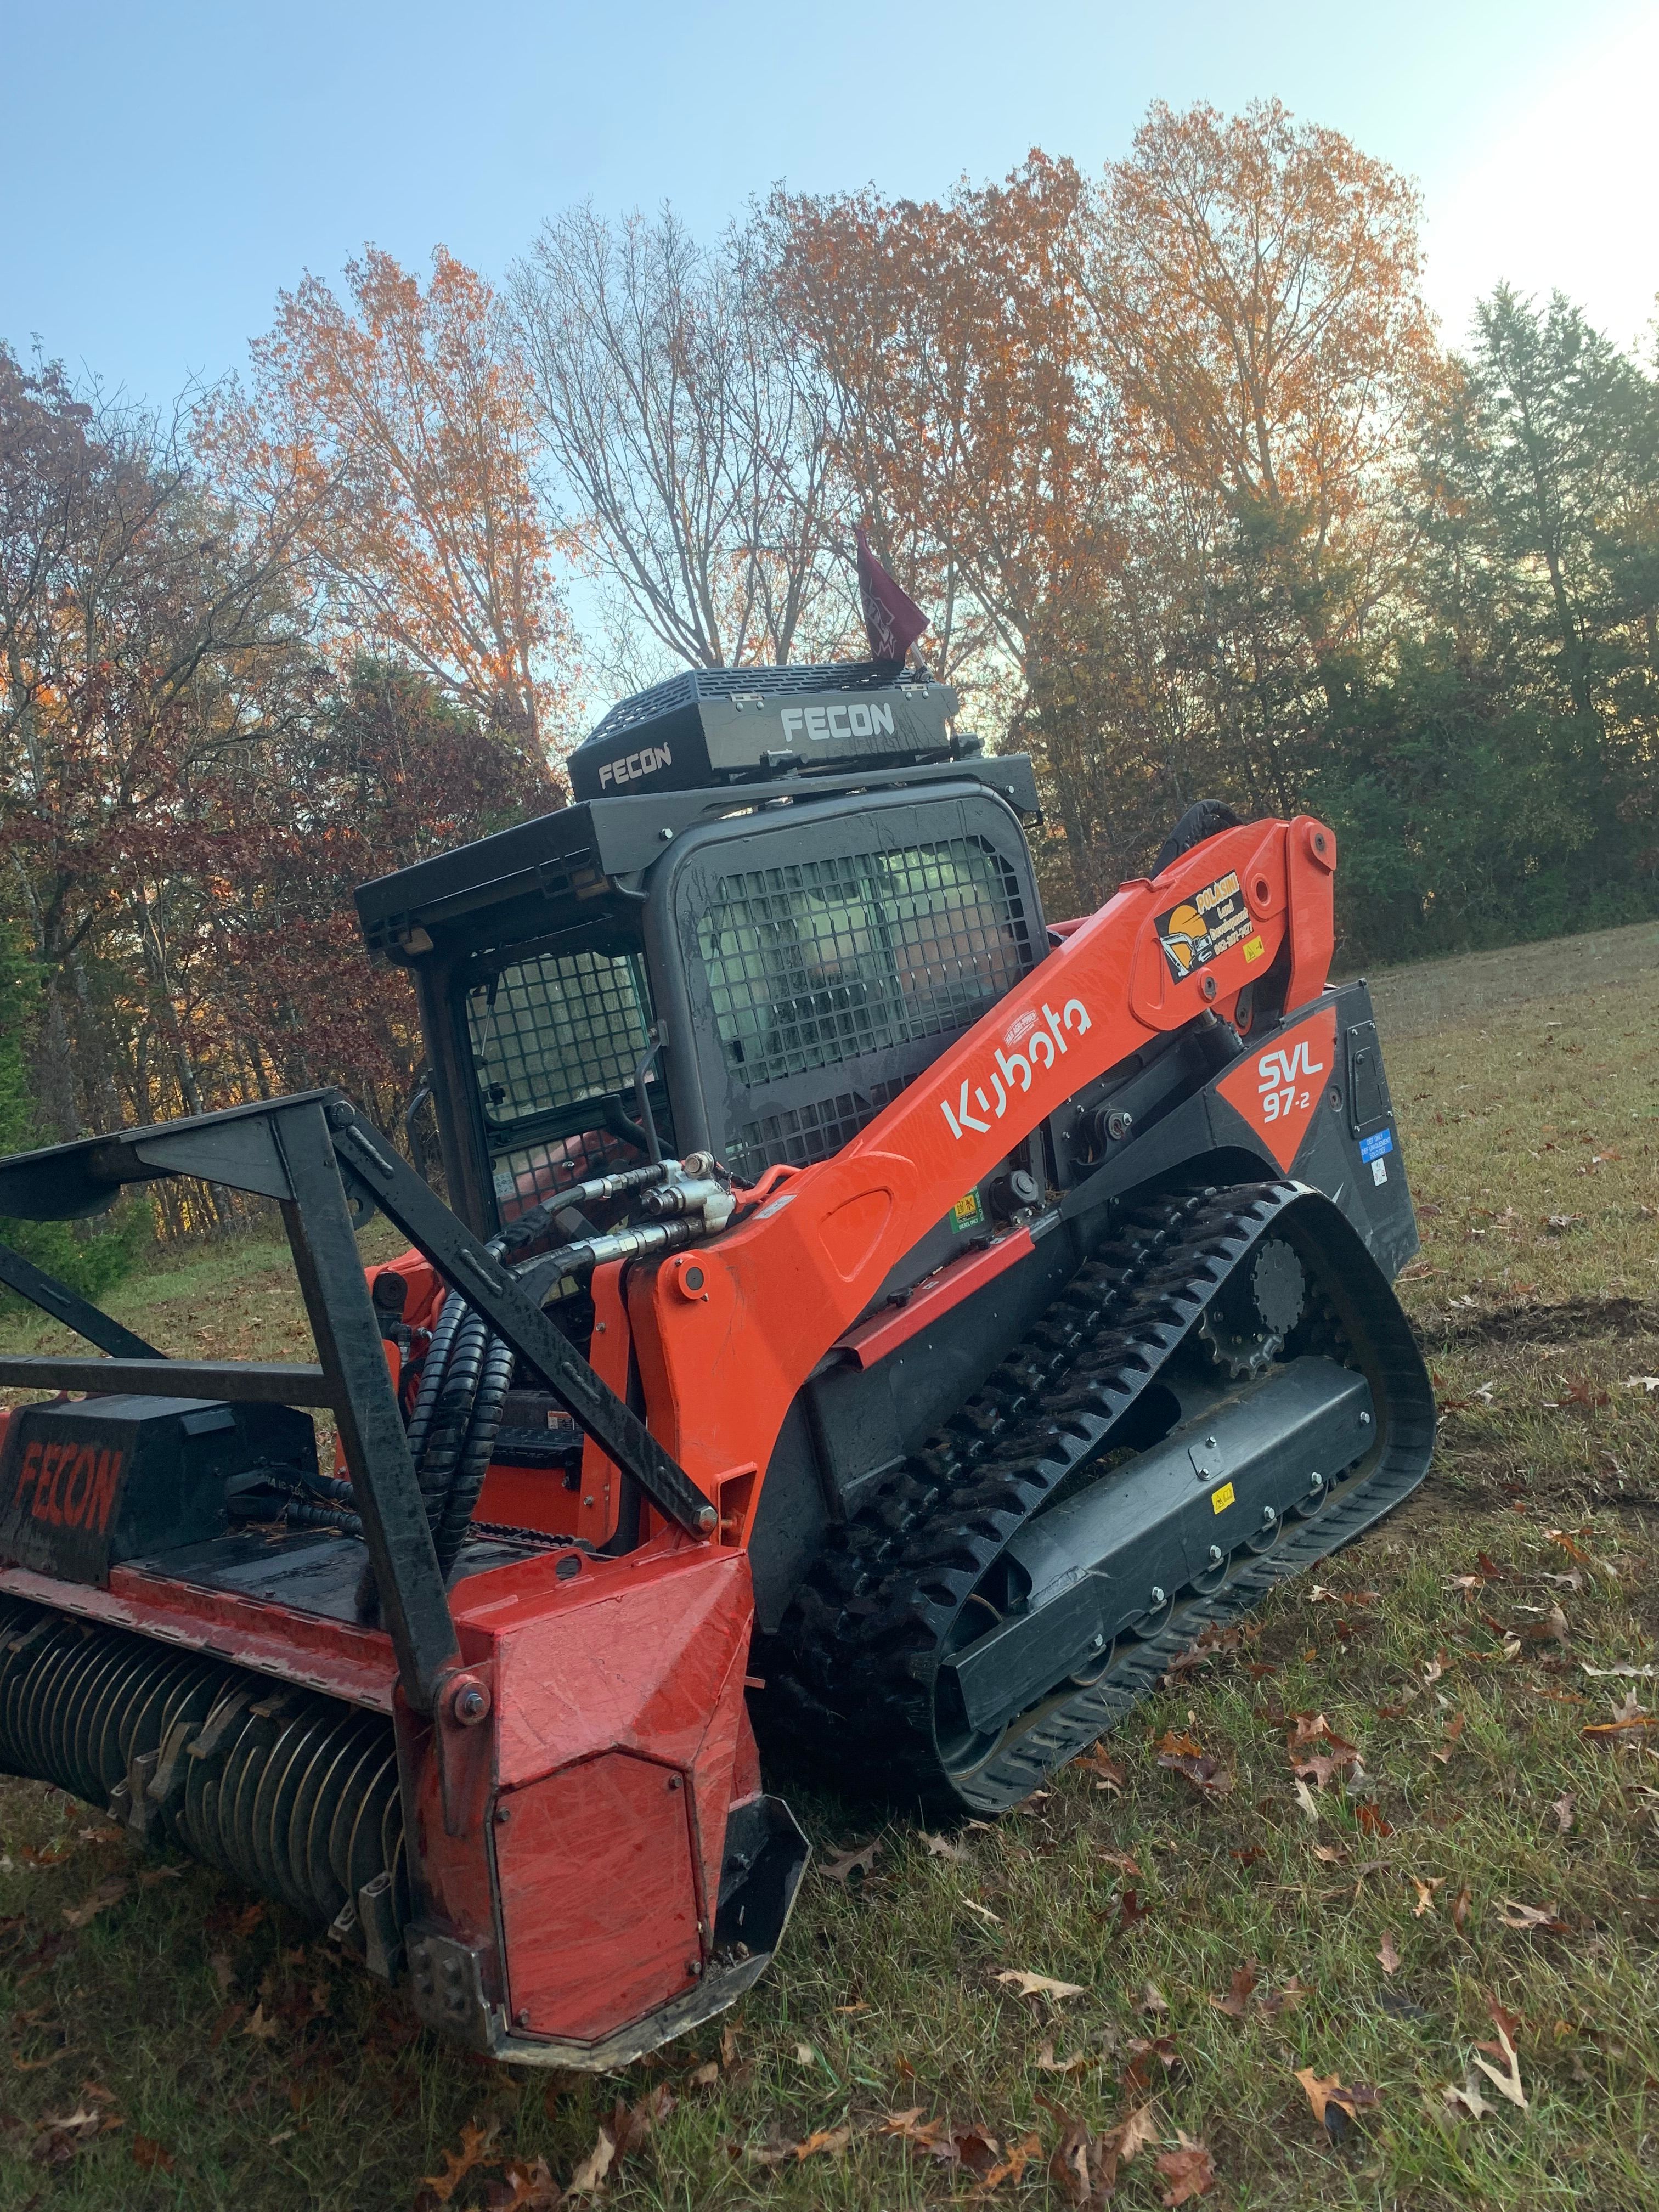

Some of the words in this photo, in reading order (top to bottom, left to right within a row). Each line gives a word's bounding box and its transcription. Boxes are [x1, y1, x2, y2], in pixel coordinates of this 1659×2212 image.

[780, 702, 895, 742] FECON
[599, 742, 672, 790] FECON
[1195, 871, 1240, 915] POLASINI
[1216, 899, 1234, 919] Land
[1209, 907, 1249, 941] Development
[940, 998, 1092, 1141] Kubota
[1258, 1041, 1323, 1093] SVL
[12, 1438, 123, 1536] FECON
